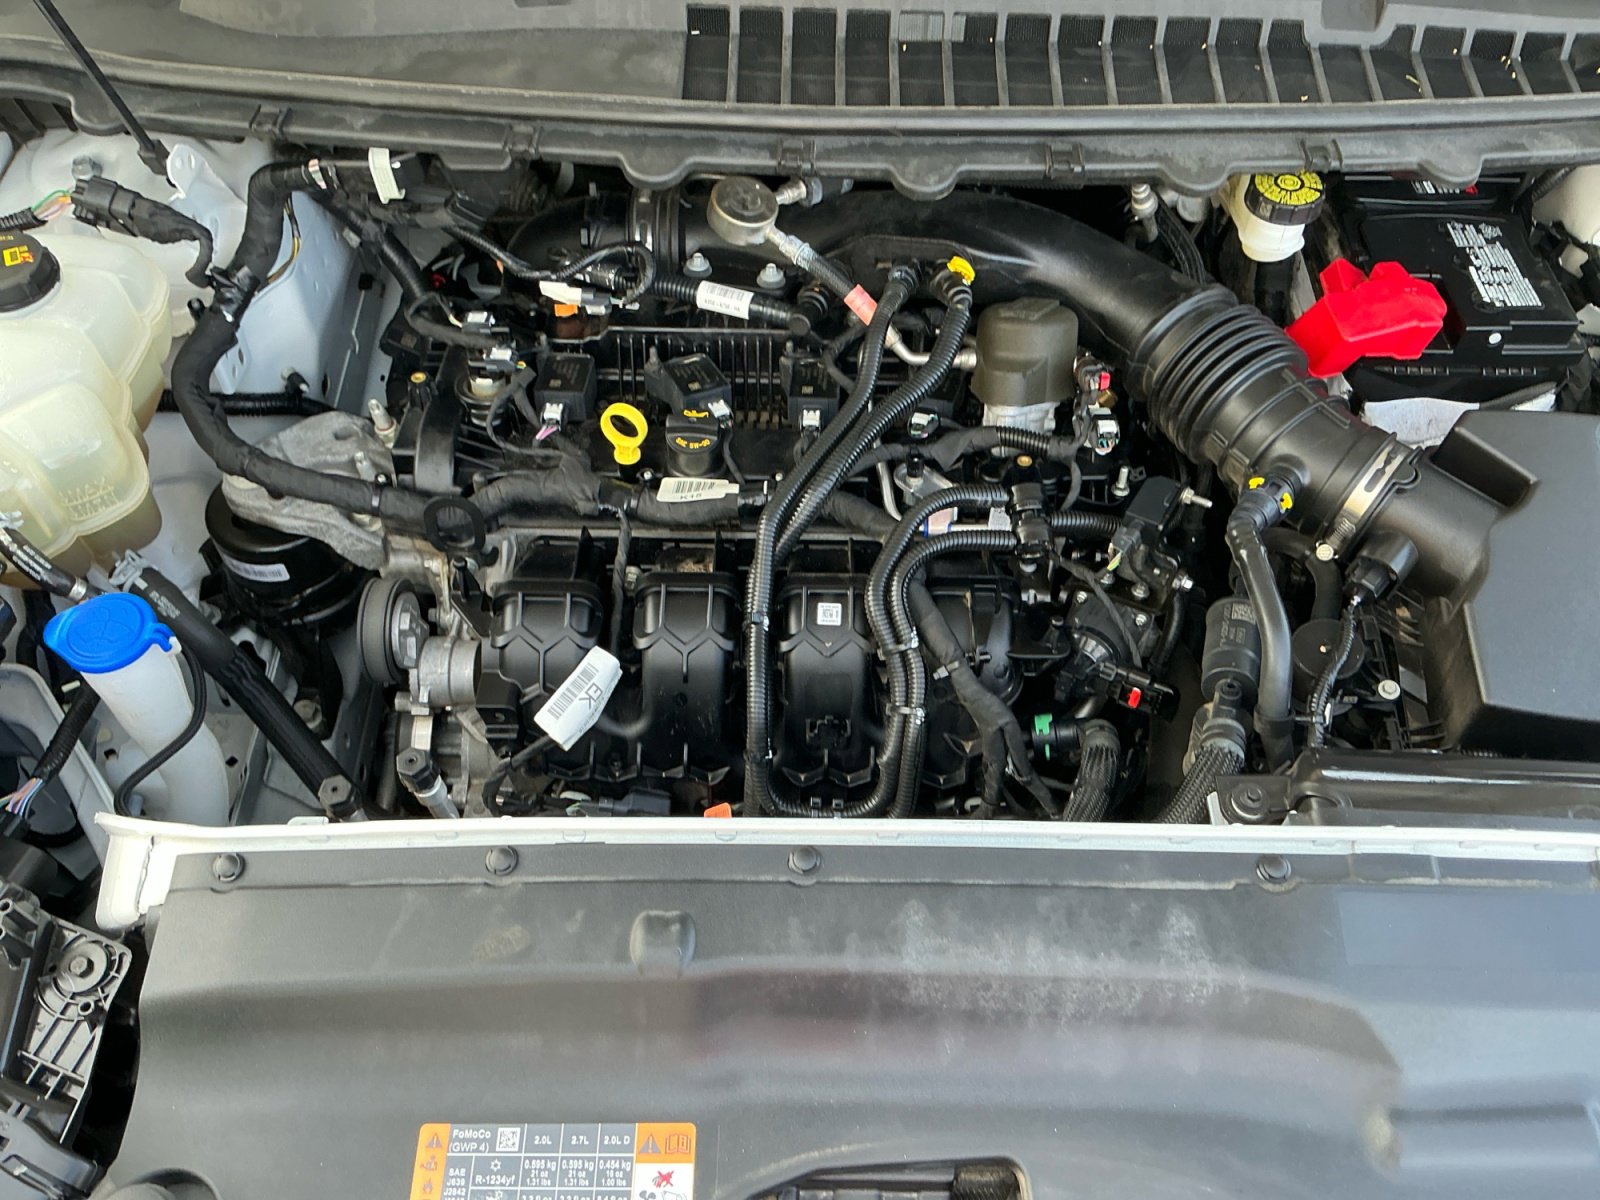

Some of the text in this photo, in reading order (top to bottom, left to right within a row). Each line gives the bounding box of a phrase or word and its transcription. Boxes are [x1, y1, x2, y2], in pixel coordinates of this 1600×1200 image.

[452, 1129, 492, 1139] FoMoCo
[533, 1135, 552, 1145] 2.0L
[571, 1135, 589, 1145] 2.7L
[603, 1135, 631, 1145] 2.0L D
[448, 1141, 490, 1154] (GWP 4)
[546, 1159, 557, 1171] kg
[584, 1159, 595, 1171] kg
[599, 1159, 632, 1171] 0.454 kg
[448, 1167, 466, 1177] SAE
[540, 1170, 549, 1178] oz
[577, 1170, 587, 1178] oz
[615, 1170, 624, 1178] oz
[446, 1178, 466, 1187] J639
[475, 1175, 516, 1187] R-1234yf
[541, 1178, 551, 1186] lbs
[578, 1178, 589, 1186] lbs
[616, 1178, 627, 1187] lbs
